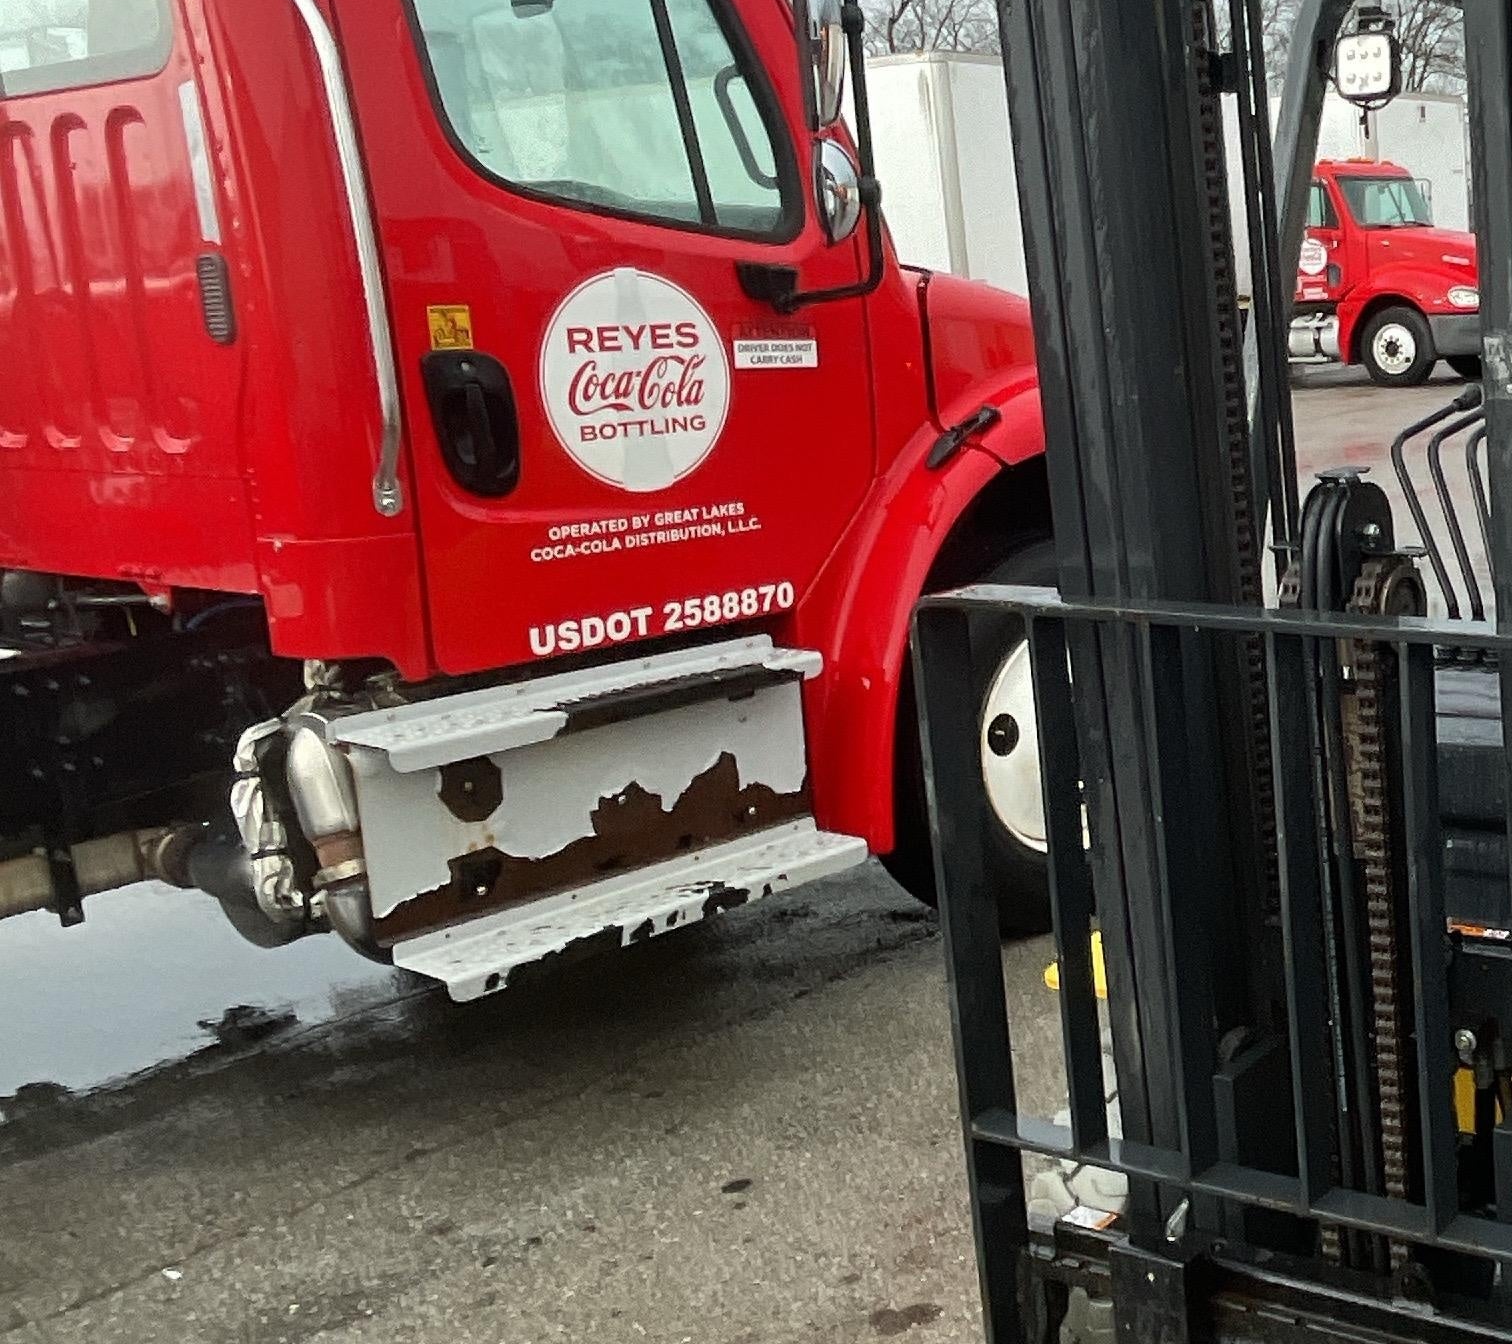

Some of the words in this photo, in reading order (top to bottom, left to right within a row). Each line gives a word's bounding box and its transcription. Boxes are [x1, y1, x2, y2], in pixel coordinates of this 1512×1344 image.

[566, 322, 700, 354] REYES
[737, 343, 770, 353] DRIVER
[771, 343, 794, 352] DOES
[795, 343, 812, 352] NOT
[750, 355, 778, 365] CARRY
[780, 355, 803, 364] CASH
[568, 354, 705, 416] Coca-Cola
[580, 415, 706, 442] BOTTLING
[548, 518, 628, 541] OPERATED
[632, 514, 650, 529] BY
[654, 508, 700, 526] GREAT
[701, 502, 745, 520] LAKES
[530, 537, 622, 562] COCA-COLA
[624, 522, 726, 549] DISTRIBUTION,
[728, 517, 762, 534] L.L.C.
[528, 606, 653, 656] USDOT
[663, 581, 795, 632] 2588870
